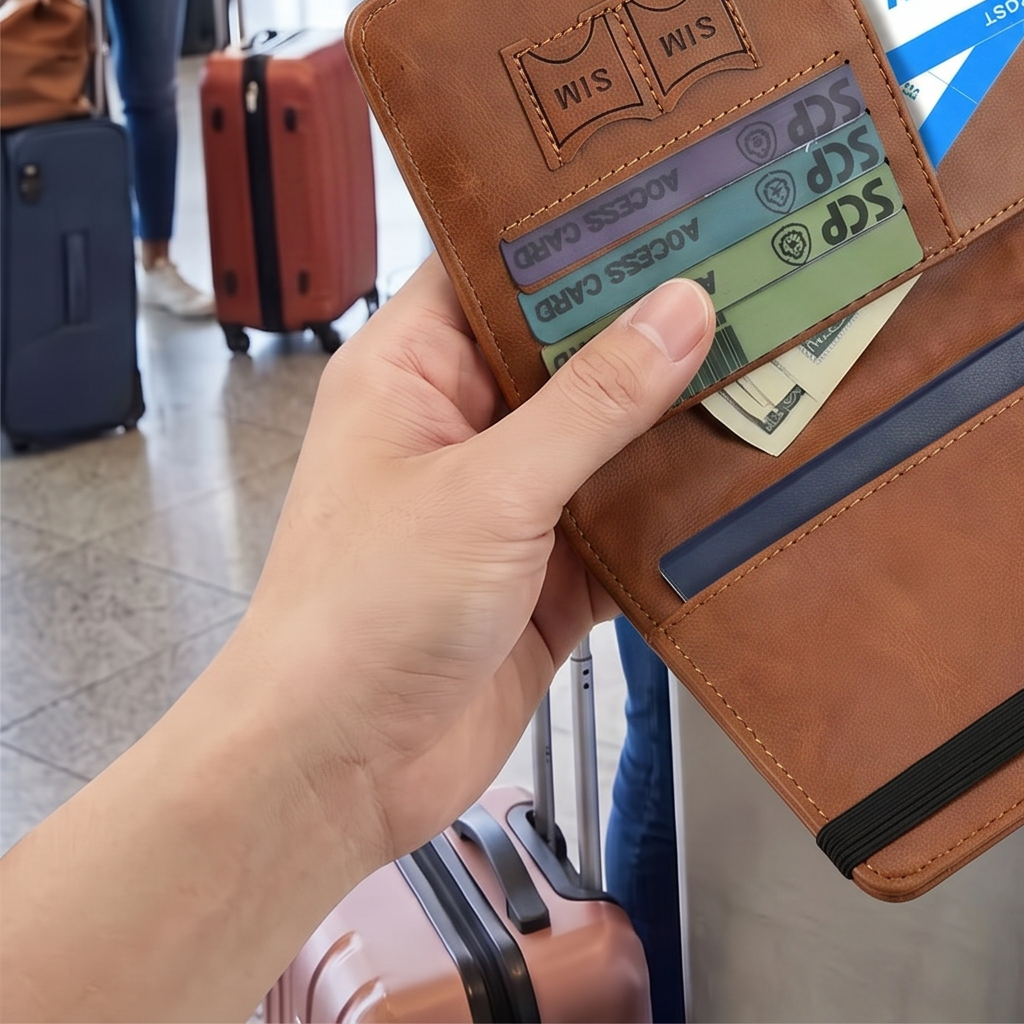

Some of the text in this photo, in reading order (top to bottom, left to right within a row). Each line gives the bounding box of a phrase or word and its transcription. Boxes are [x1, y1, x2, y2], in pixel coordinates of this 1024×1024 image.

[659, 16, 717, 58] SIM
[553, 68, 613, 110] SIM
[787, 77, 862, 141] SCP
[806, 124, 880, 194] SCP
[821, 176, 895, 246] SCP
[513, 221, 582, 270] CARD
[534, 273, 603, 323] CARD
